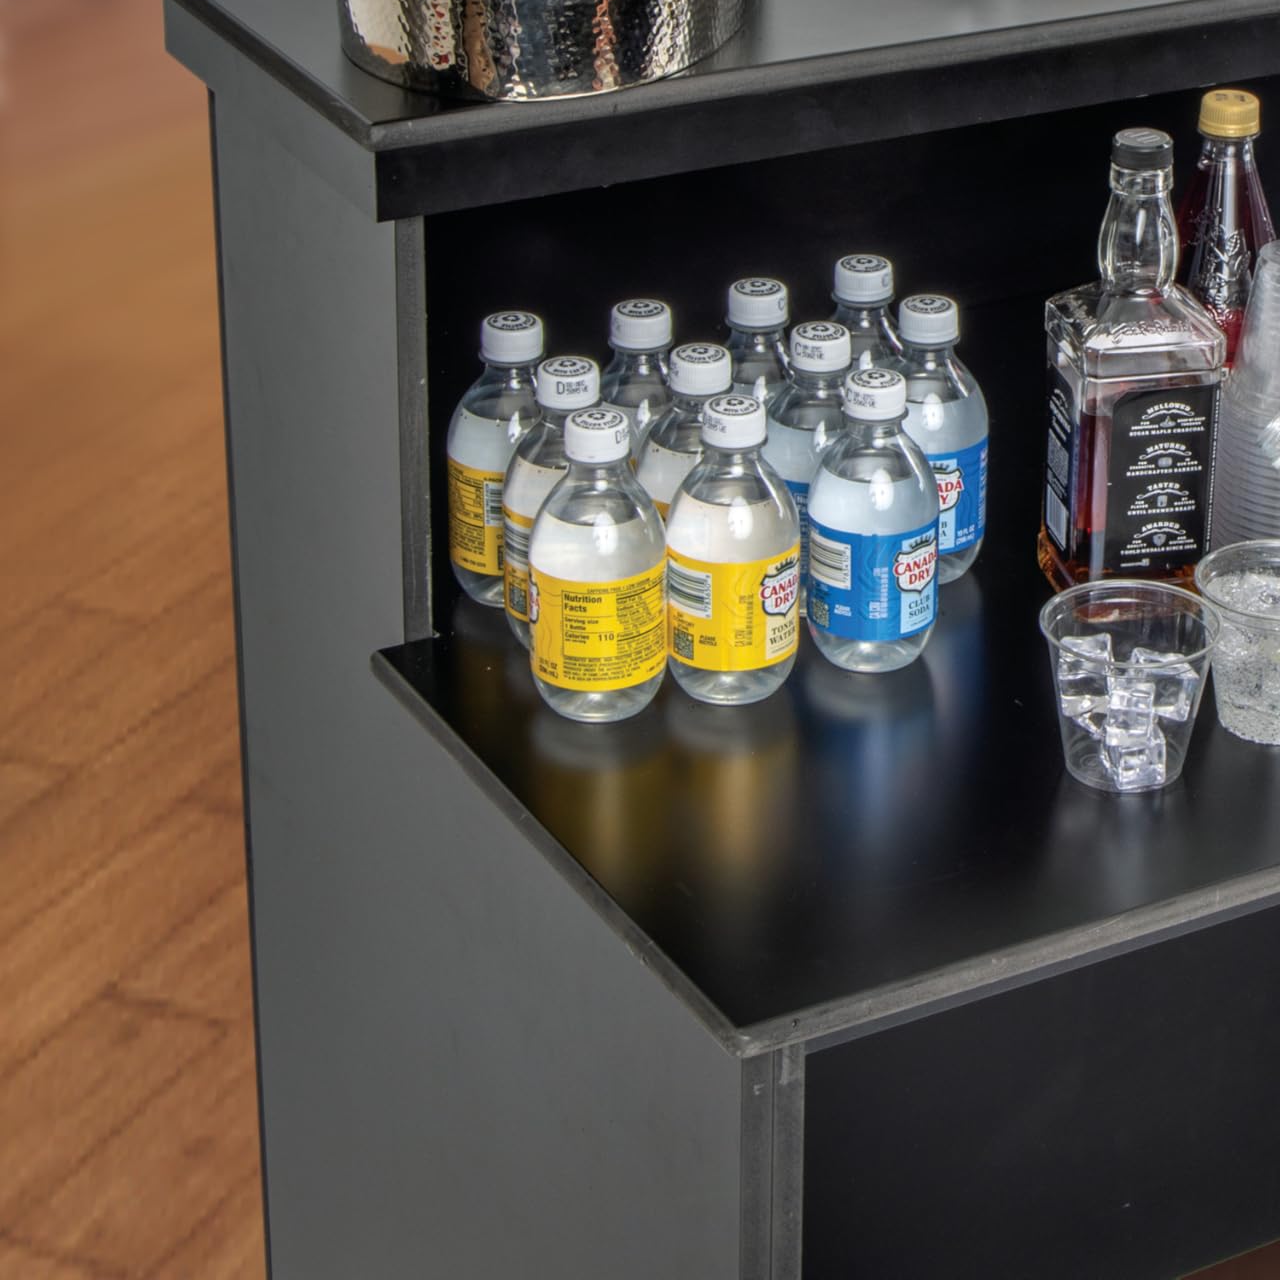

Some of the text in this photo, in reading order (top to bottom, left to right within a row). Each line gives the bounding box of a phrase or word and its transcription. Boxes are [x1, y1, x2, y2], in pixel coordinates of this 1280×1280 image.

[1146, 403, 1191, 414] MELLOWED
[1146, 442, 1186, 453] MATURED
[937, 478, 964, 493] ADA
[1147, 482, 1180, 491] TASTED
[1142, 522, 1180, 532] AWARDED
[909, 568, 930, 585] DRY
[760, 574, 798, 599] CANAD
[564, 593, 602, 604] Nutrition
[775, 590, 794, 608] DRY
[564, 603, 587, 612] Facts
[565, 616, 585, 625] Serving
[565, 632, 614, 641] Calories 110
